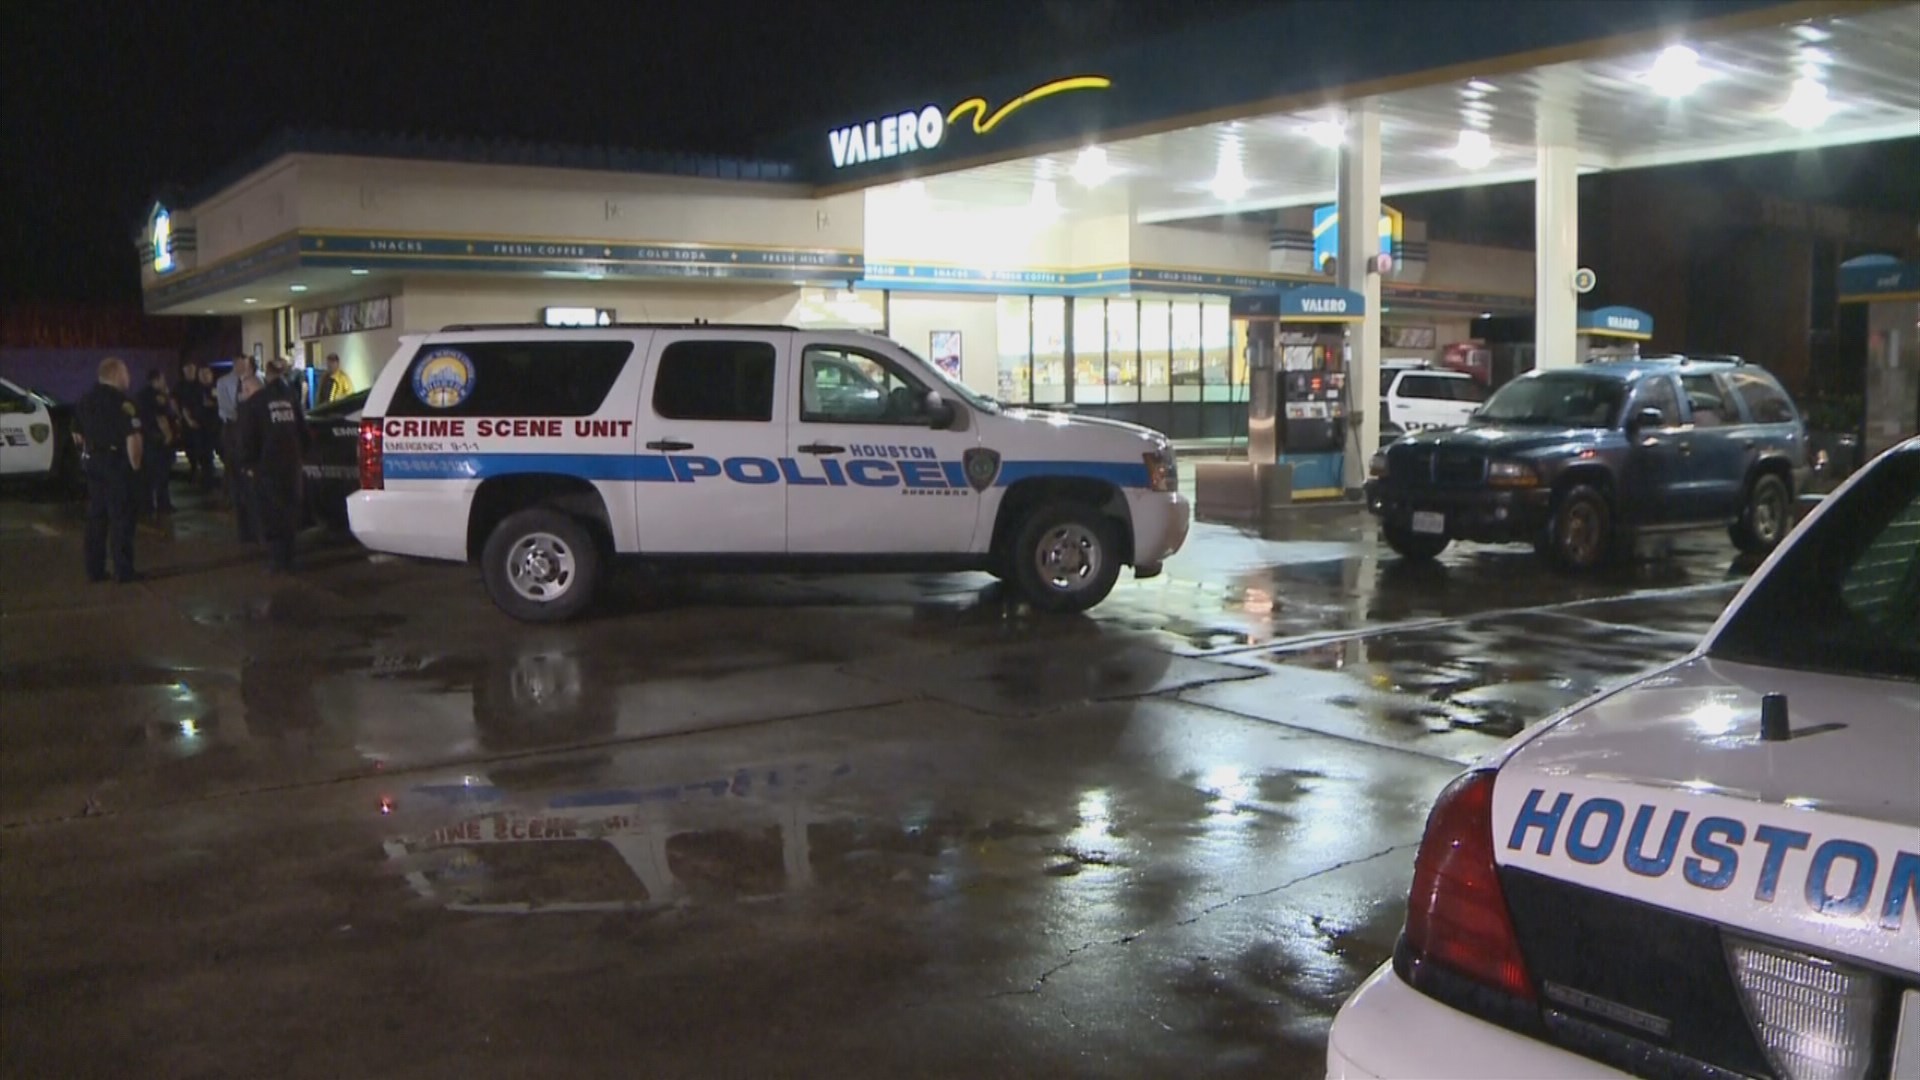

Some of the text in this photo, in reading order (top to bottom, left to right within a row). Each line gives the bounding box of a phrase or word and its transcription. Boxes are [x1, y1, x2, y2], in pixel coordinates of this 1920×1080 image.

[828, 104, 944, 168] VALERO
[369, 240, 422, 252] SNACKS
[494, 244, 585, 257] FRESH COFFEE
[638, 249, 706, 261] COLD SODA
[762, 253, 795, 264] FRESH
[1301, 298, 1347, 313] VALERO
[1606, 315, 1640, 331] VALERO
[384, 419, 633, 438] CRIME SCENE UNIT
[384, 441, 443, 451] EMERGENCY
[849, 443, 937, 460] HOUSTON
[668, 456, 949, 488] POLICE
[1507, 787, 1920, 931] HOUSTON
